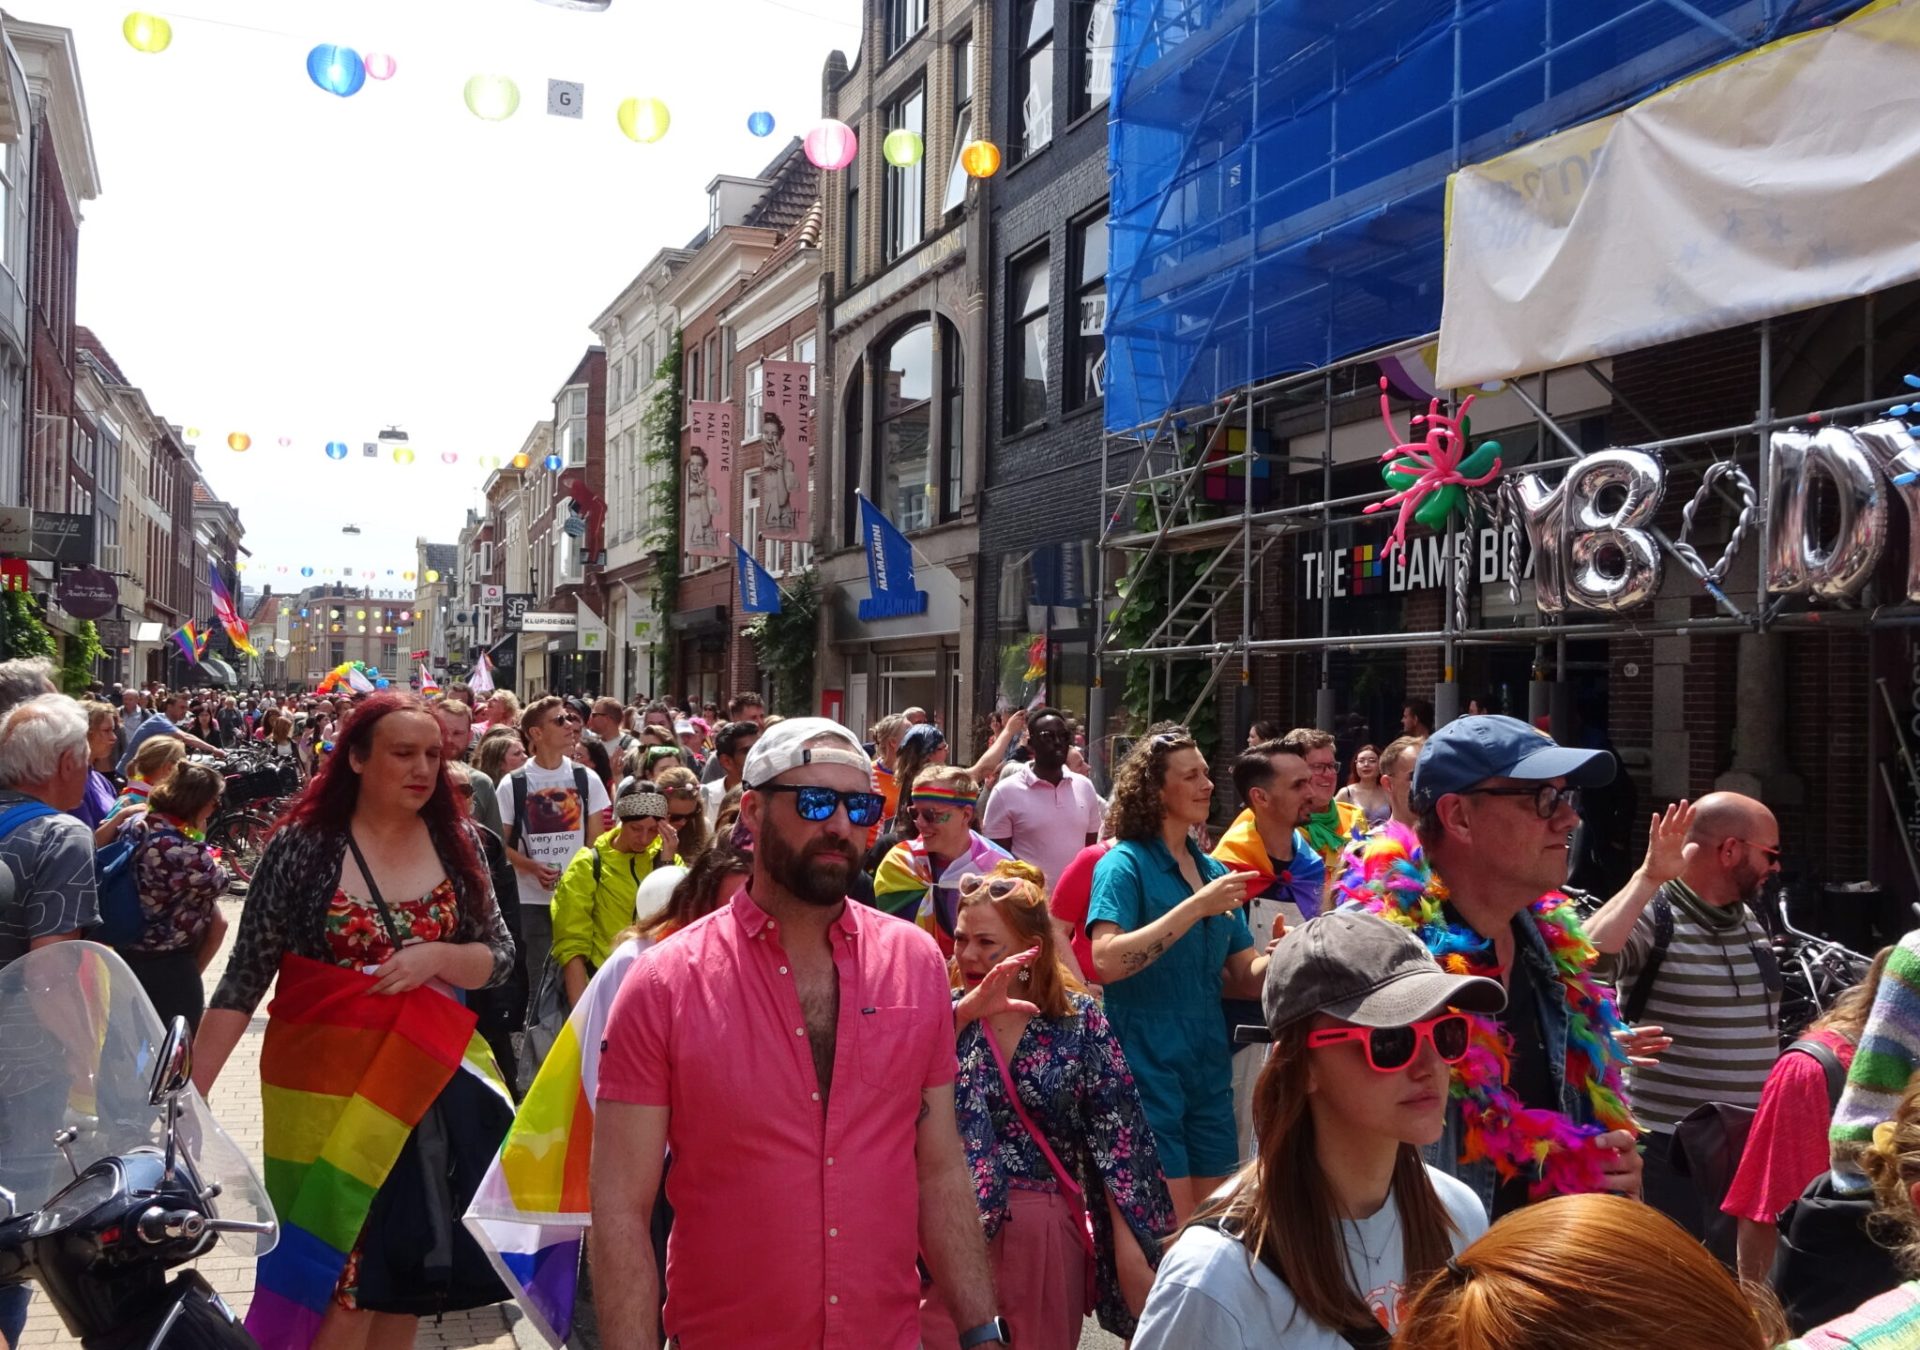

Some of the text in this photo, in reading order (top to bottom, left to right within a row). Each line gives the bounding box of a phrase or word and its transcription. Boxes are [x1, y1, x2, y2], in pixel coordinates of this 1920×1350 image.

[560, 92, 571, 107] G
[766, 371, 776, 398] LAB
[782, 373, 792, 407] NAIL
[692, 411, 701, 434] LAB
[799, 374, 809, 443] CREATIVE
[707, 412, 716, 441] NAIL
[720, 413, 730, 473] CREATIVE
[871, 524, 888, 592] MAMAMINI
[745, 557, 758, 607] MAMAMIN
[1302, 548, 1347, 600] THE
[530, 835, 552, 843] very
[552, 846, 570, 855] gay
